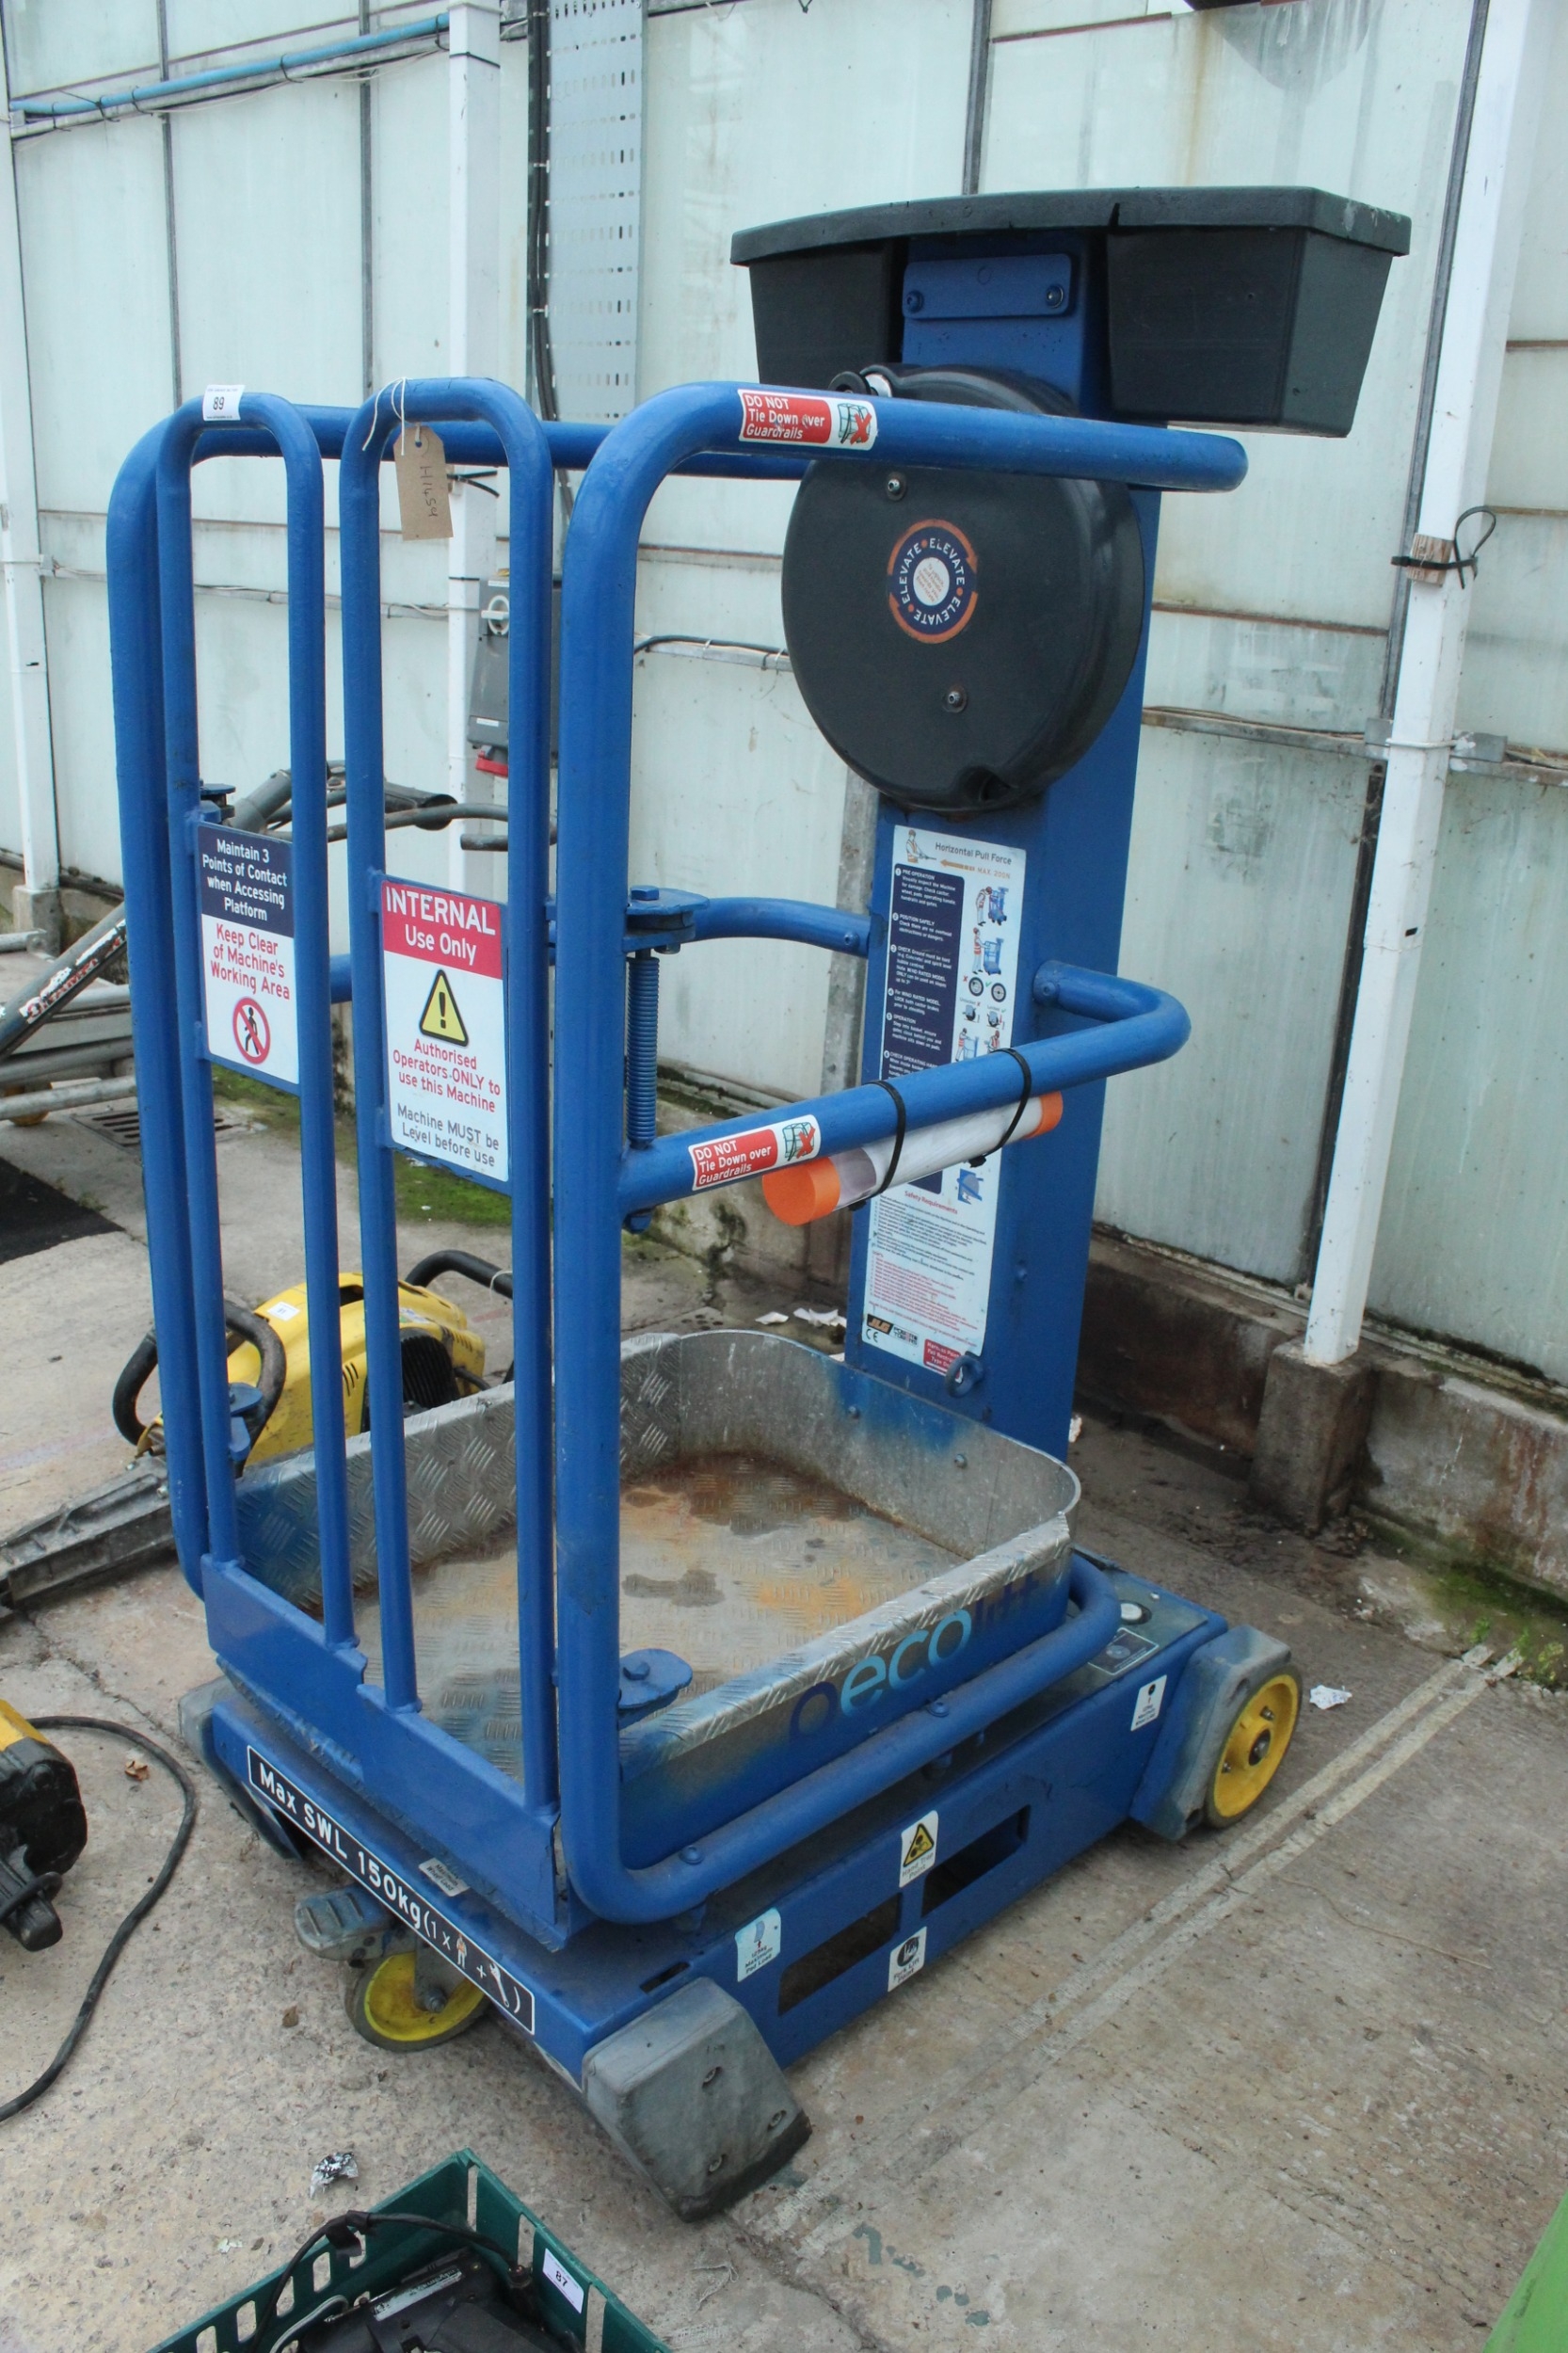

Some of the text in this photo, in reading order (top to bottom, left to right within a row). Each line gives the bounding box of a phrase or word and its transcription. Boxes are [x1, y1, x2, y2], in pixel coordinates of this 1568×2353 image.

[213, 396, 225, 410] 89
[744, 394, 789, 409] DO NOT
[748, 408, 765, 422] Tie
[768, 410, 798, 424] Down
[745, 424, 803, 440] Guardrails
[899, 542, 922, 604] ELEVATE
[929, 537, 965, 585] ELEVATE
[913, 596, 962, 626] ELEVATE
[216, 838, 270, 863] Maintain 3
[936, 842, 1012, 865] Horizontal Pull Force
[202, 854, 288, 888] Points of Contact
[207, 875, 285, 910] when Accessing
[224, 897, 267, 921] Platform
[386, 886, 496, 936] INTERNAL
[216, 923, 279, 956] Keep Clear
[405, 923, 477, 967] Use Only
[213, 943, 285, 979] of Machine's
[210, 960, 290, 1000] Working Area
[414, 1038, 477, 1070] Authorised
[392, 1048, 501, 1096] Operators ONLY to
[399, 1071, 496, 1112] use this Machine
[397, 1103, 500, 1151] Machine MUST be
[402, 1123, 495, 1167] Level before use
[695, 1140, 737, 1161] DO NOT
[699, 1145, 772, 1174] Tie Down over
[698, 1162, 752, 1185] Guardrails
[260, 1762, 297, 1815] Max
[303, 1802, 347, 1860] SWL
[358, 1850, 421, 1929] 150kg
[555, 2270, 568, 2287] 87
